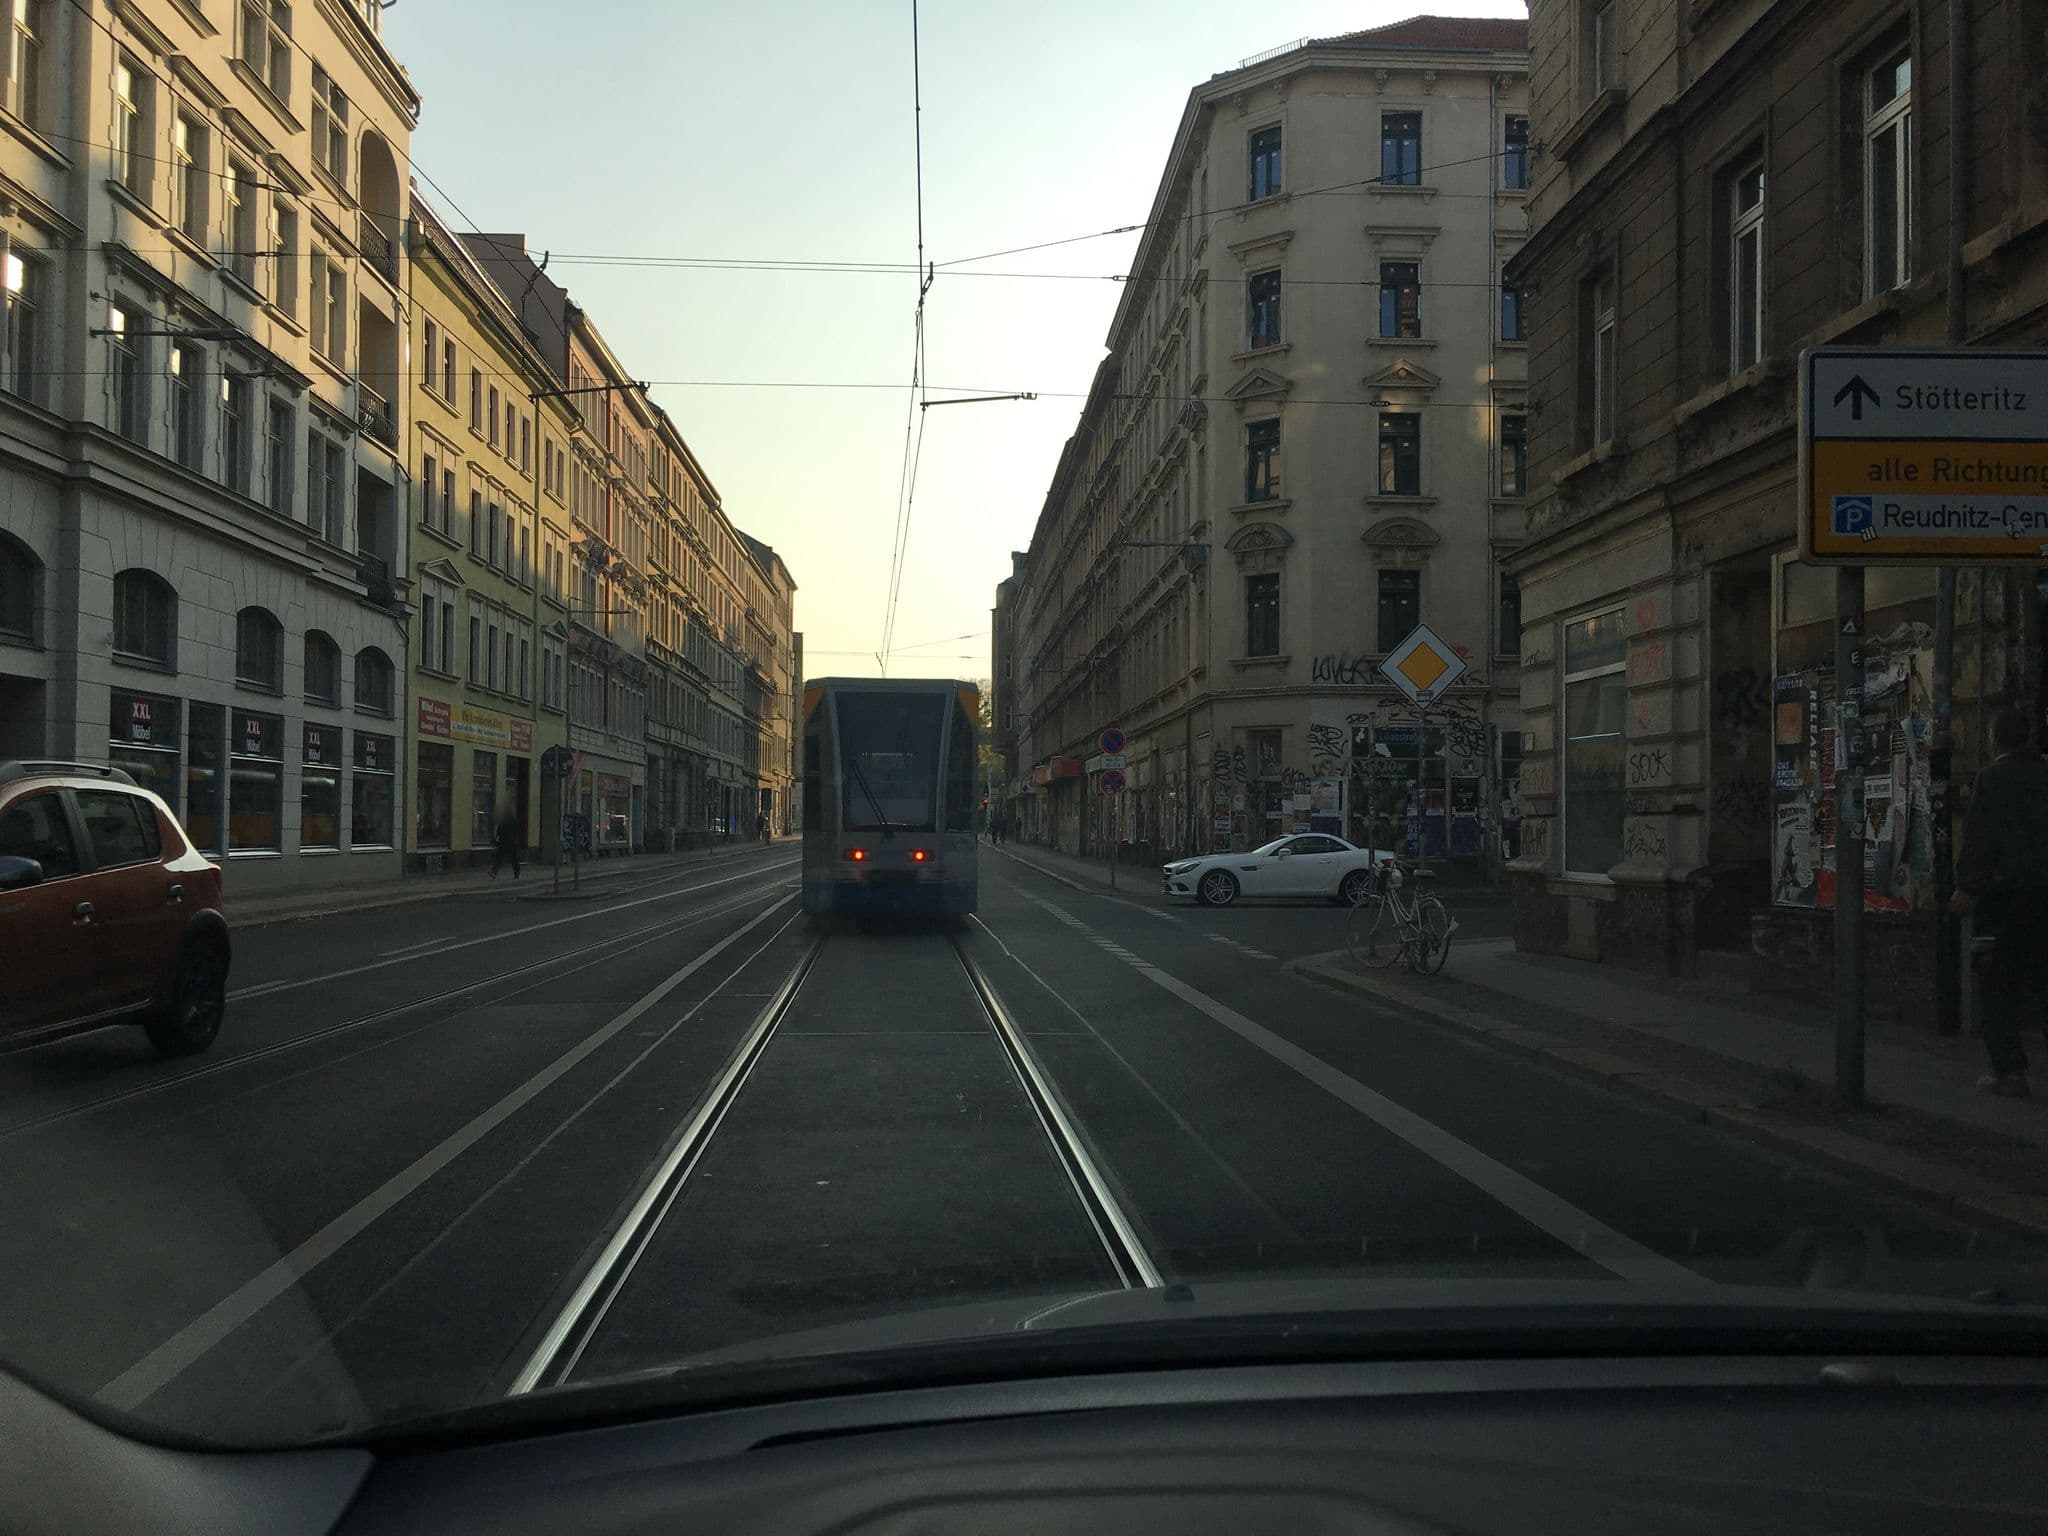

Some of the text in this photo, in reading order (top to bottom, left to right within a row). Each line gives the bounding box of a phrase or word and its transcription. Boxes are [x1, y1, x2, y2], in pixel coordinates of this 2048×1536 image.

[1896, 384, 2027, 411] Stötteritz
[1868, 457, 1919, 482] alle
[132, 701, 151, 720] XXL
[246, 719, 261, 735] XXL
[308, 731, 321, 745] XXL
[1809, 689, 1818, 770] RELEASE
